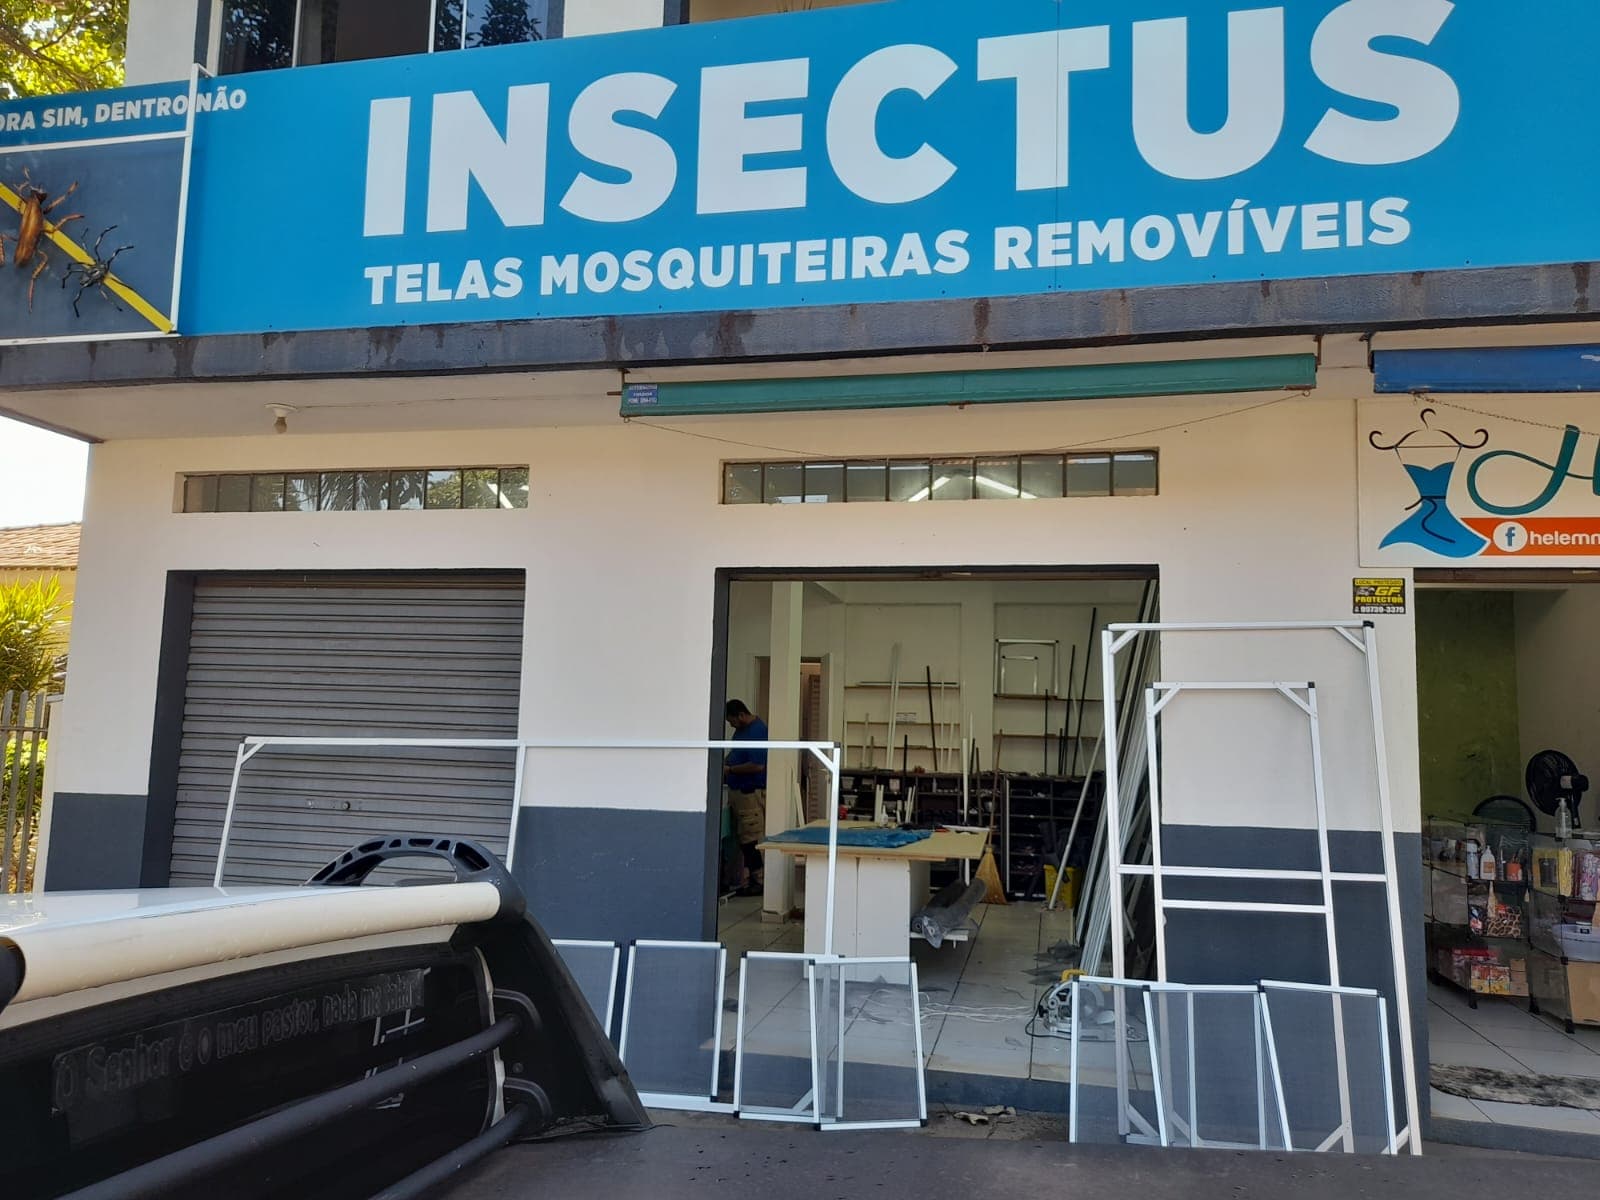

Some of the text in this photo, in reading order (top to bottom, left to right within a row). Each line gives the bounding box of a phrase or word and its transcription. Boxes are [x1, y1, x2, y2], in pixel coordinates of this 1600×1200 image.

[42, 106, 88, 128] SIM,
[95, 95, 188, 123] DENTRO
[196, 86, 247, 113] NÃO
[364, 0, 1460, 237] INSECTUS
[364, 197, 1411, 305] TELAS MOSQUITEIRAS REMOVÍVEIS
[1355, 596, 1403, 604] PROTECTOR
[216, 1014, 258, 1060] meu
[321, 983, 359, 1026] nada
